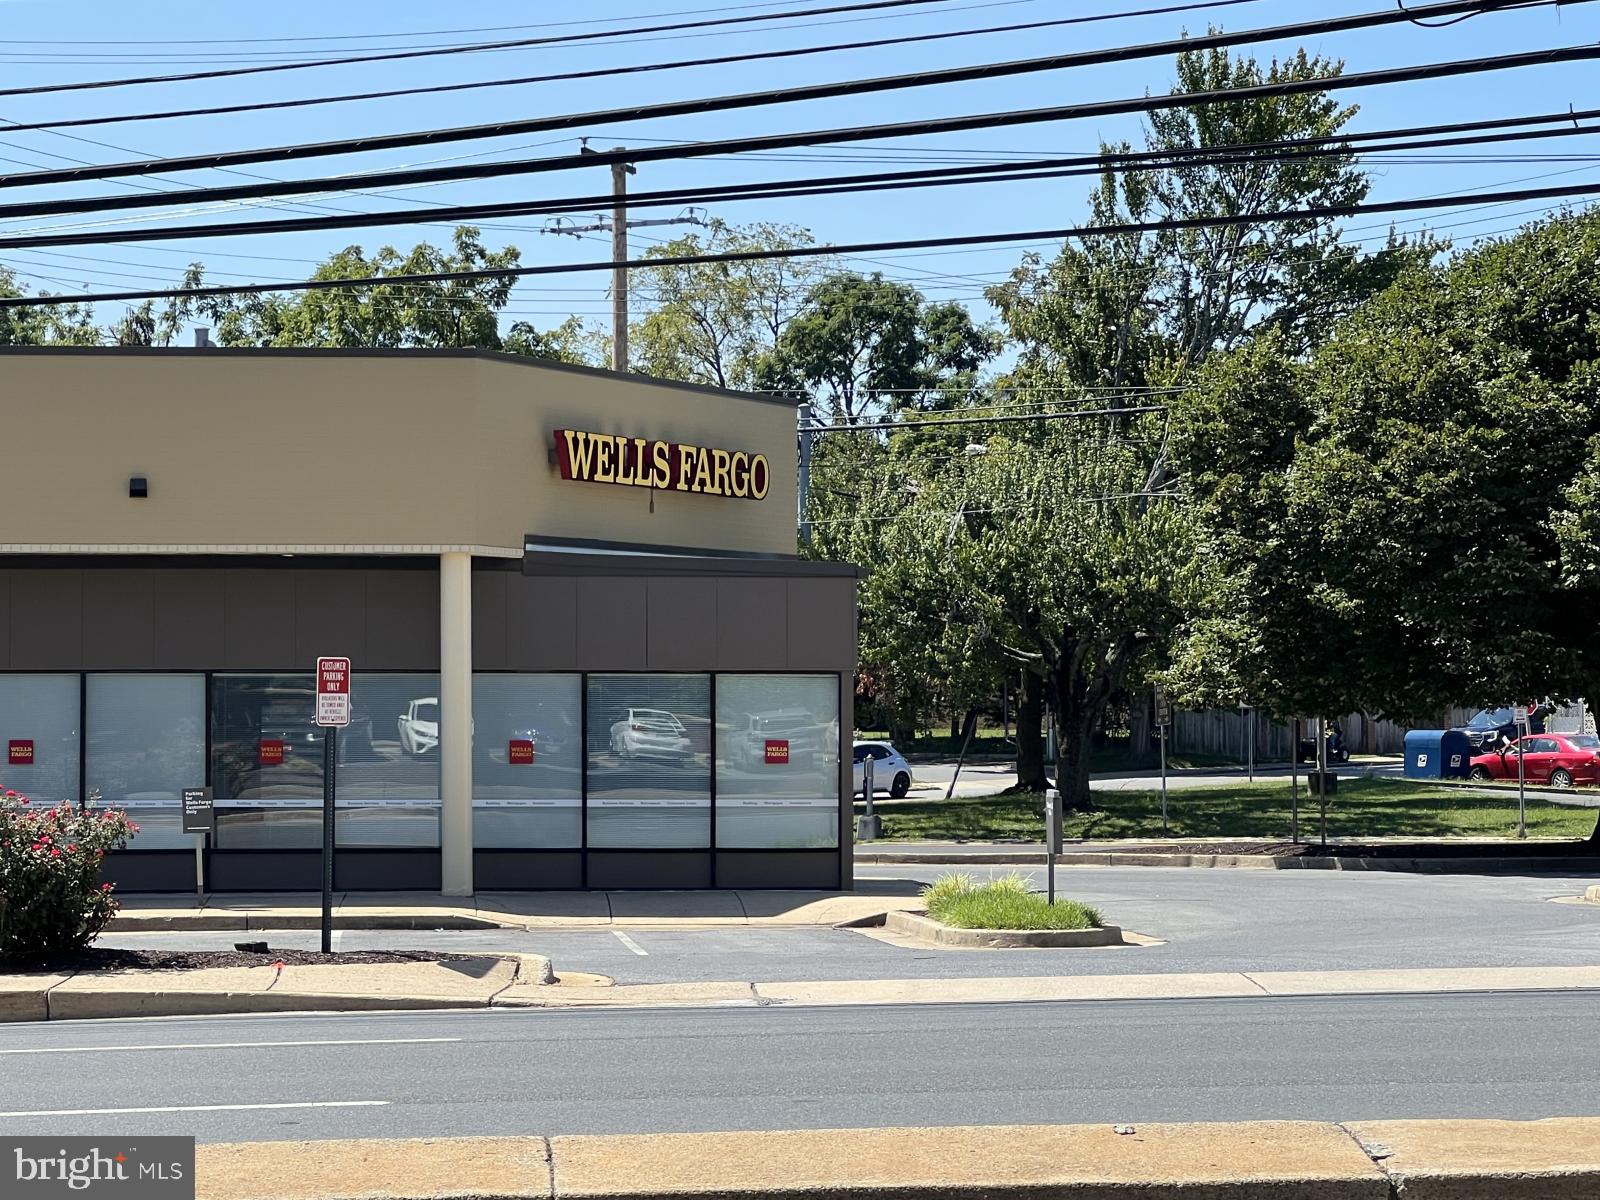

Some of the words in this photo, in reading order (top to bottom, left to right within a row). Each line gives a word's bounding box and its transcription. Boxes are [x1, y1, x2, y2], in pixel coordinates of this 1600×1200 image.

[564, 429, 671, 489] WELLS
[676, 443, 770, 500] FARGO
[321, 661, 346, 671] CUSTOMER
[323, 672, 344, 681] PARKING
[326, 682, 340, 691] ONLY
